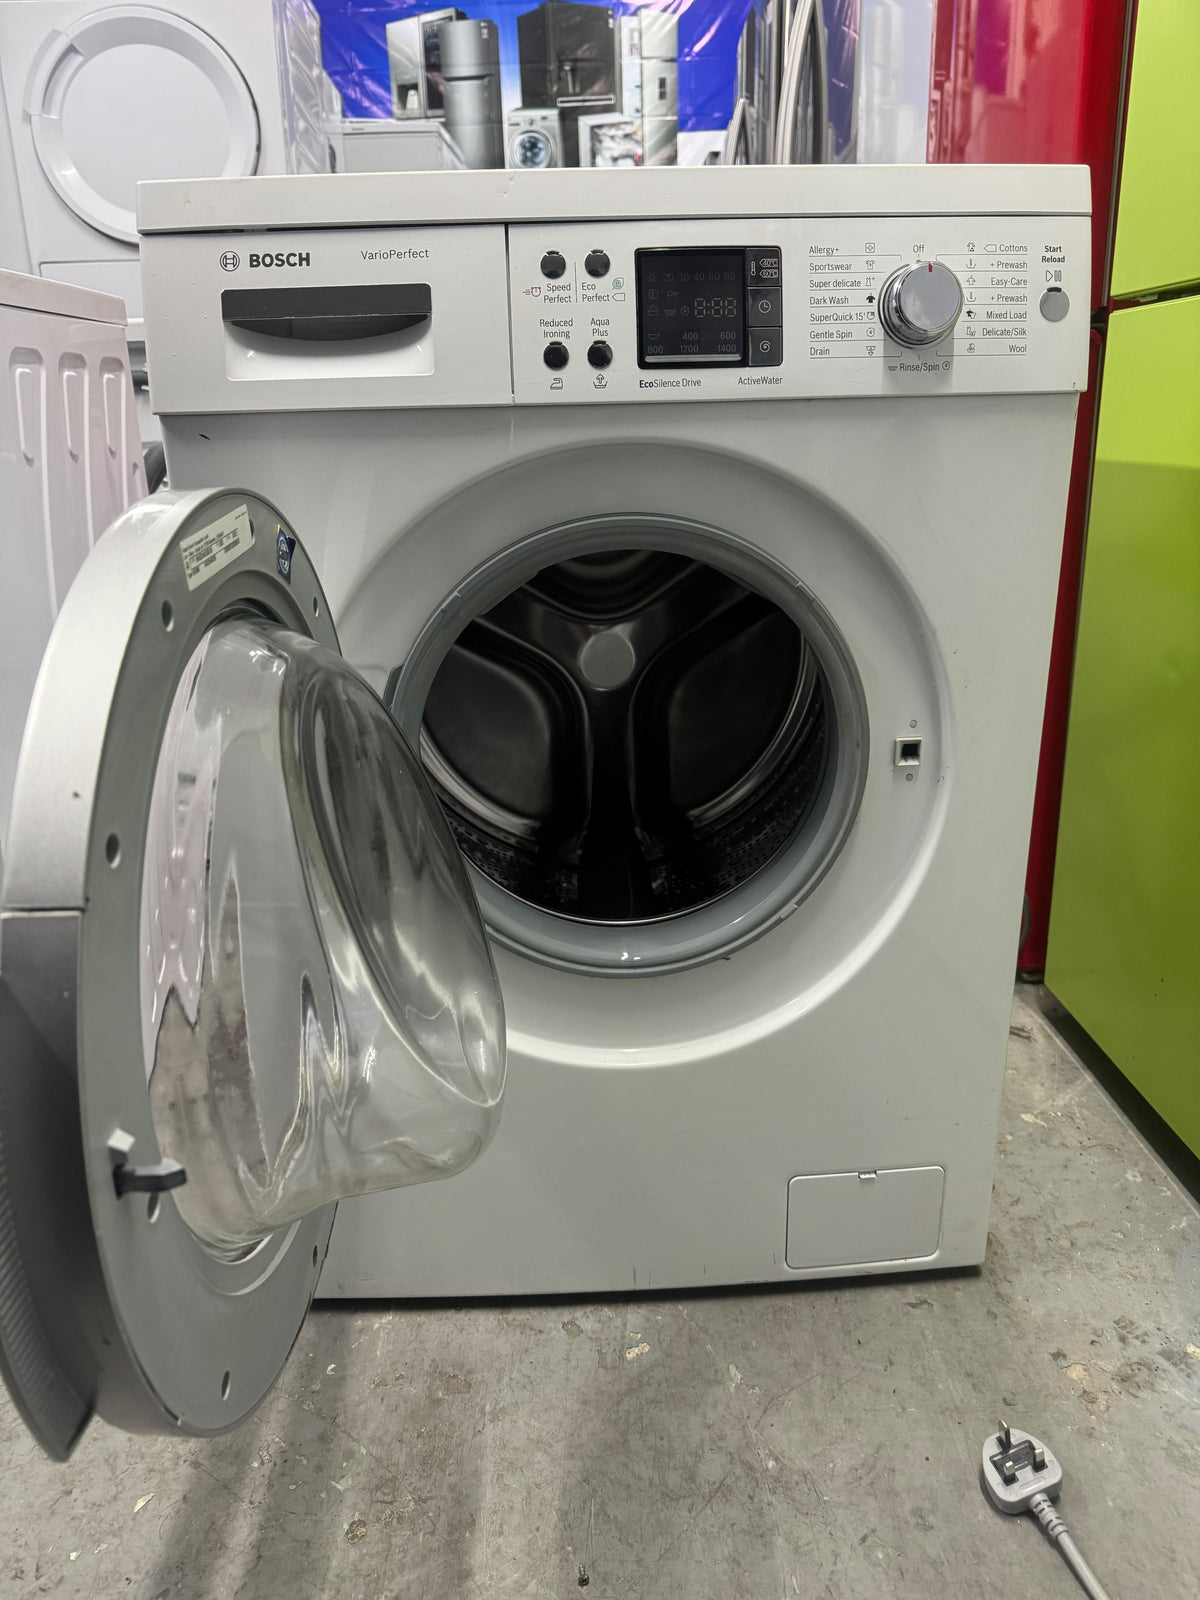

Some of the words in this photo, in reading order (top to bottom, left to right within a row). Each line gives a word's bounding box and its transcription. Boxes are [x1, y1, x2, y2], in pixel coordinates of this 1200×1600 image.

[809, 245, 840, 256] Allergy+
[913, 244, 924, 253] Off
[999, 243, 1028, 253] Cottons
[1044, 245, 1063, 253] Start
[361, 249, 430, 260] VarioPerfect
[1041, 255, 1066, 264] Reload
[249, 252, 311, 268] BOSCH
[996, 260, 1028, 269] Prewash
[809, 262, 852, 273] Sportswear
[581, 282, 596, 291] Eco
[809, 280, 831, 290] Super
[832, 279, 862, 288] delicate
[990, 277, 1028, 287] Easy-Care
[546, 283, 571, 293] Speed
[543, 295, 572, 304] Perfect
[581, 294, 610, 302] Perfect
[809, 296, 828, 305] Dark
[829, 295, 849, 304] Wash
[996, 294, 1028, 303] Prewash
[810, 312, 854, 323] SuperQuick
[986, 310, 1008, 320] Mixed
[1009, 309, 1027, 319] Load
[540, 317, 574, 327] Reduced
[590, 317, 610, 327] Aqua
[543, 329, 571, 340] Ironing
[592, 328, 609, 337] Plus
[682, 332, 699, 341] 400
[720, 331, 737, 340] 600
[809, 330, 835, 340] Gentle
[835, 329, 853, 339] Spin
[982, 327, 1027, 337] Delicate/Silk
[647, 345, 664, 354] 800
[680, 344, 699, 353] 1200
[717, 344, 737, 353] 1400
[809, 346, 830, 356] Drain
[1008, 343, 1027, 353] Wool
[899, 361, 940, 373] Rinse/Spin
[639, 378, 681, 389] EcoSilence
[681, 377, 702, 387] Drive
[737, 375, 783, 386] ActiveWater
